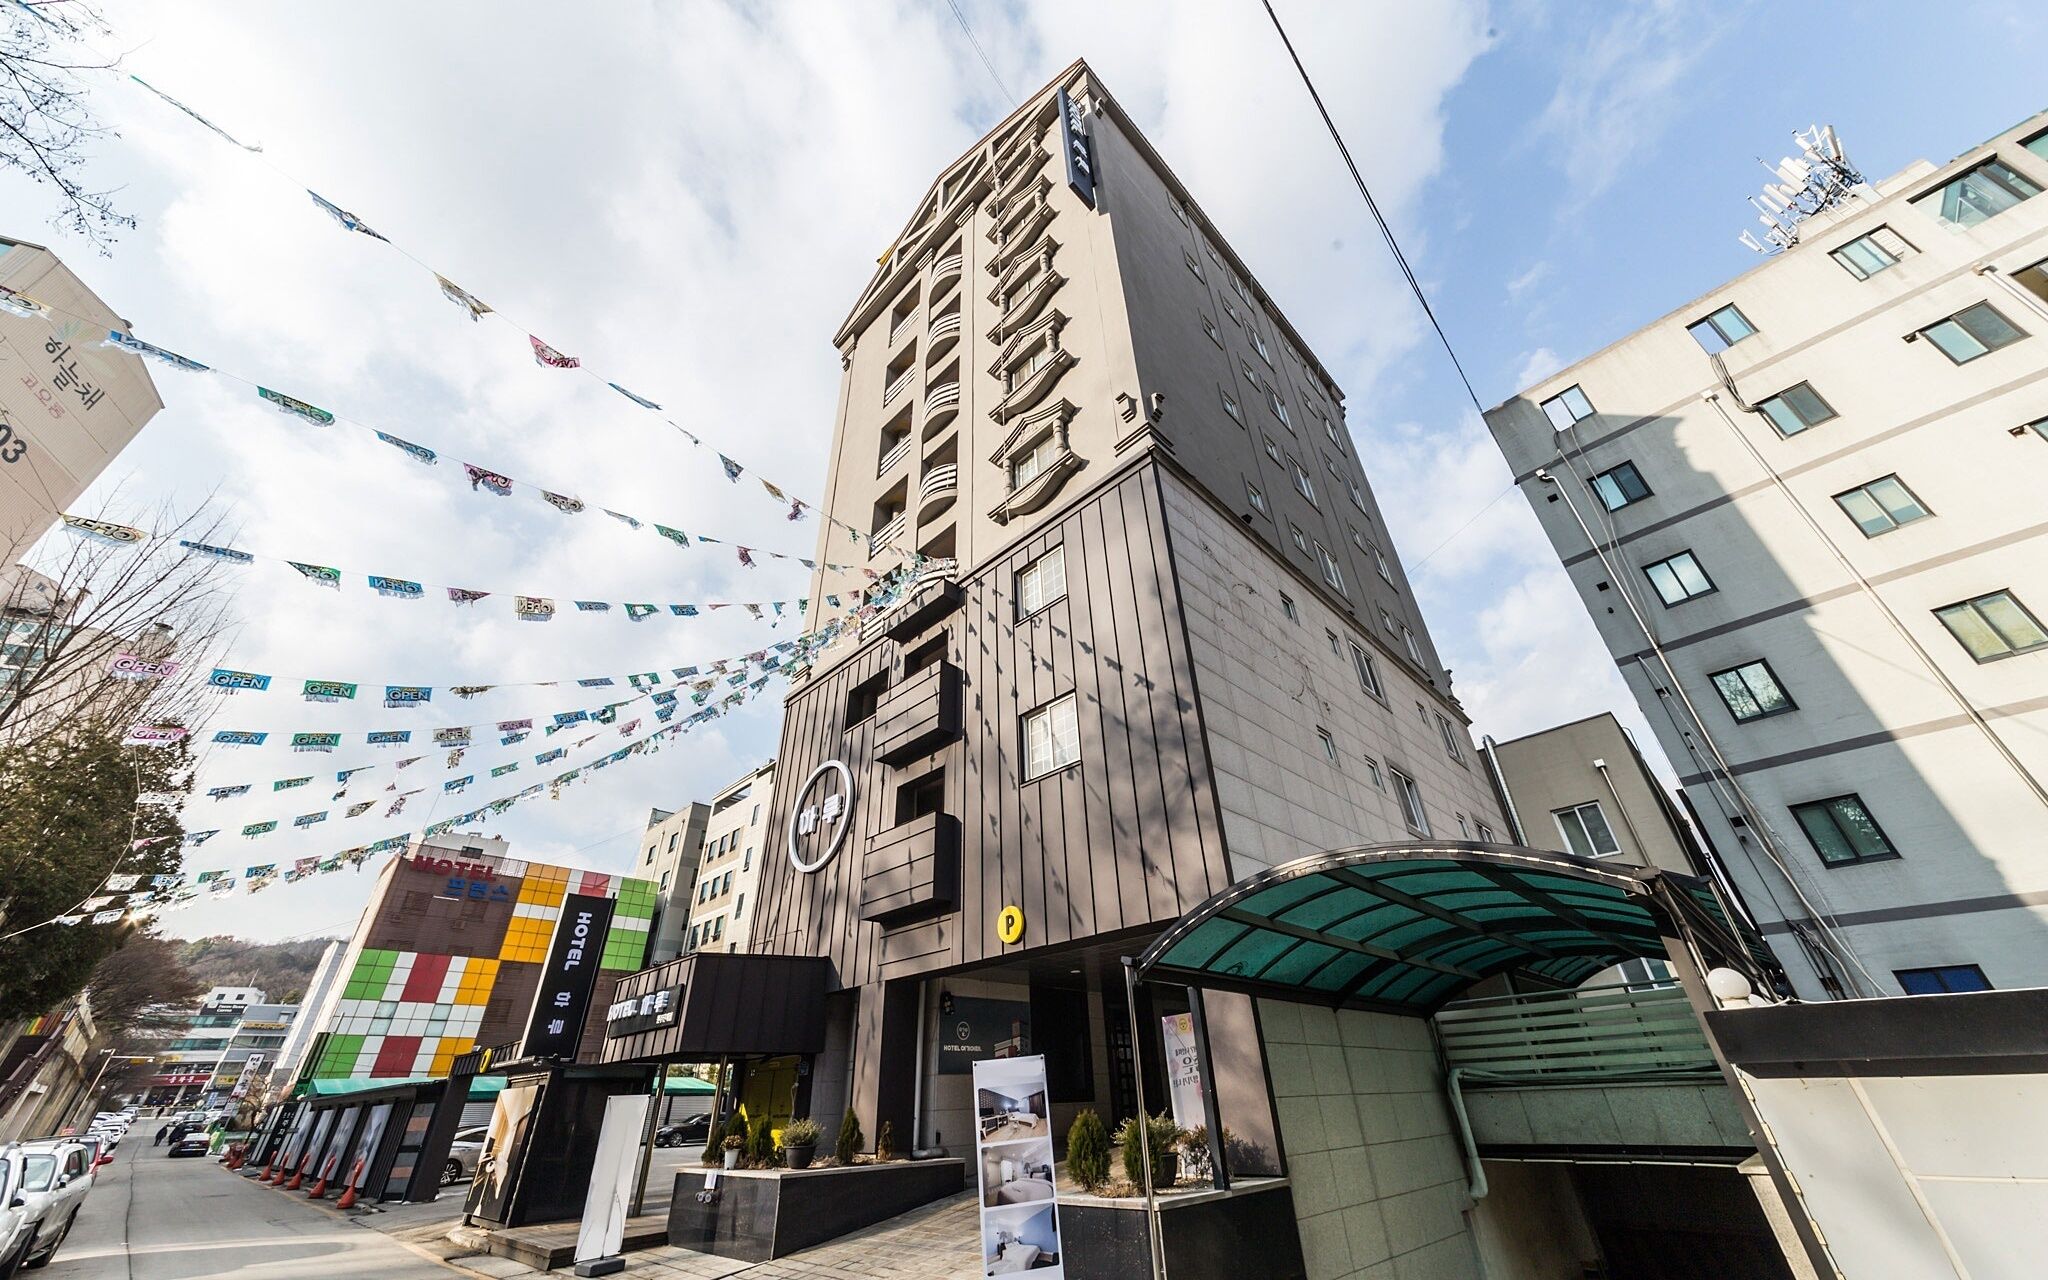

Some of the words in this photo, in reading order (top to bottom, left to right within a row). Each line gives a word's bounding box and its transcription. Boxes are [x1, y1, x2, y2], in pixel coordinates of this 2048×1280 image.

[45, 336, 105, 411] 하늘채
[115, 657, 174, 676] OPEN
[214, 674, 266, 689] OPEN
[307, 685, 351, 697] OPEN
[388, 688, 429, 701] OPEN
[216, 732, 262, 745] OPEN
[296, 734, 337, 745] OPEN
[369, 733, 408, 742] OPEN
[799, 793, 843, 837] 하루
[244, 824, 274, 834] OPEN
[410, 855, 496, 881] MOTEL
[1005, 914, 1015, 936] P
[563, 912, 593, 971] HOTEL
[606, 999, 638, 1022] HOTEL
